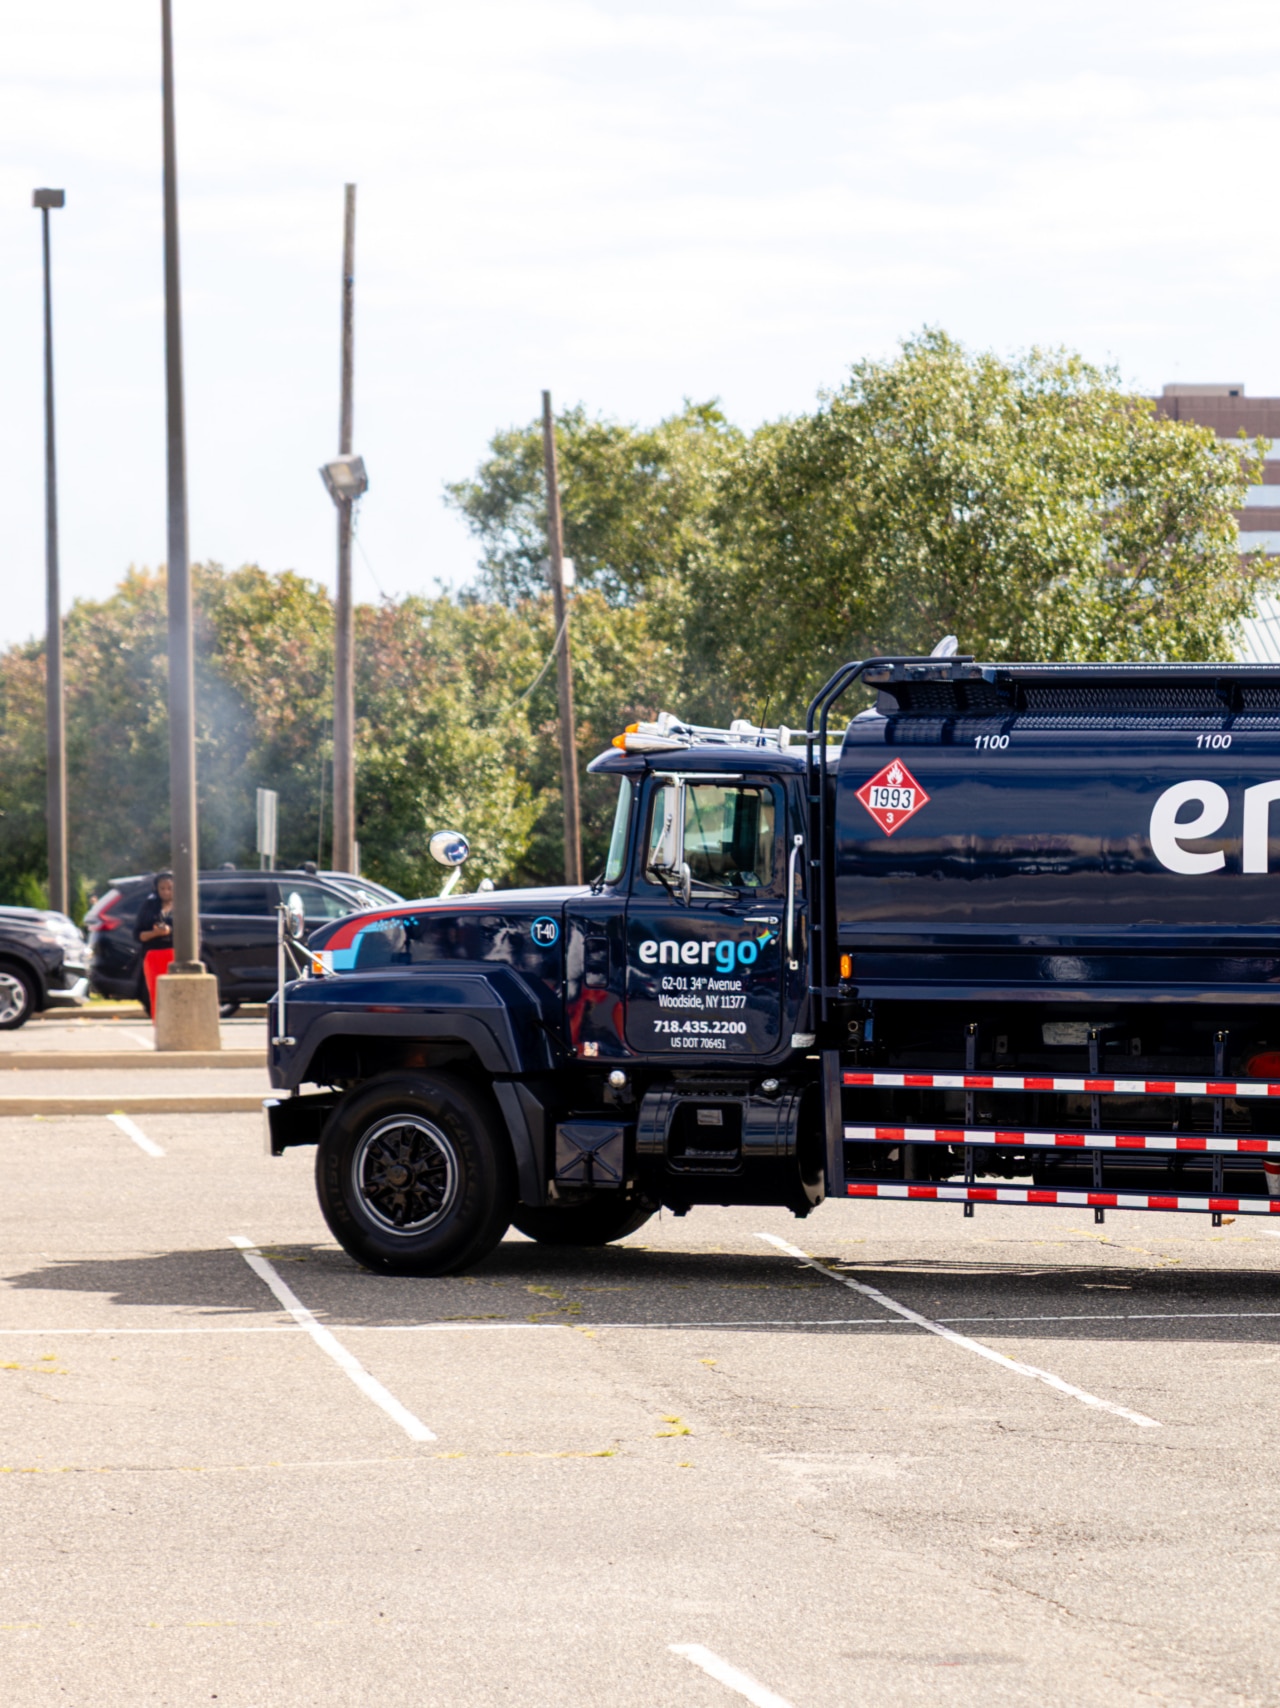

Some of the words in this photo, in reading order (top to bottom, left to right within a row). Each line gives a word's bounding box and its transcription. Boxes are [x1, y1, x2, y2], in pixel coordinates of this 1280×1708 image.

[974, 735, 1010, 749] 1100
[1195, 734, 1232, 749] 1100
[873, 788, 912, 809] 1993
[886, 812, 894, 824] 3
[535, 924, 555, 939] T-40
[639, 939, 758, 973] energo
[662, 977, 688, 990] 62-01
[690, 977, 707, 991] 34th
[708, 978, 742, 991] Avenue
[658, 994, 704, 1010] Woodside,
[706, 995, 719, 1008] NY
[721, 996, 747, 1009] 11377
[653, 1020, 747, 1034] 718.435.2200
[671, 1037, 681, 1048] US
[683, 1037, 698, 1048] DOT
[700, 1038, 726, 1049] 706451
